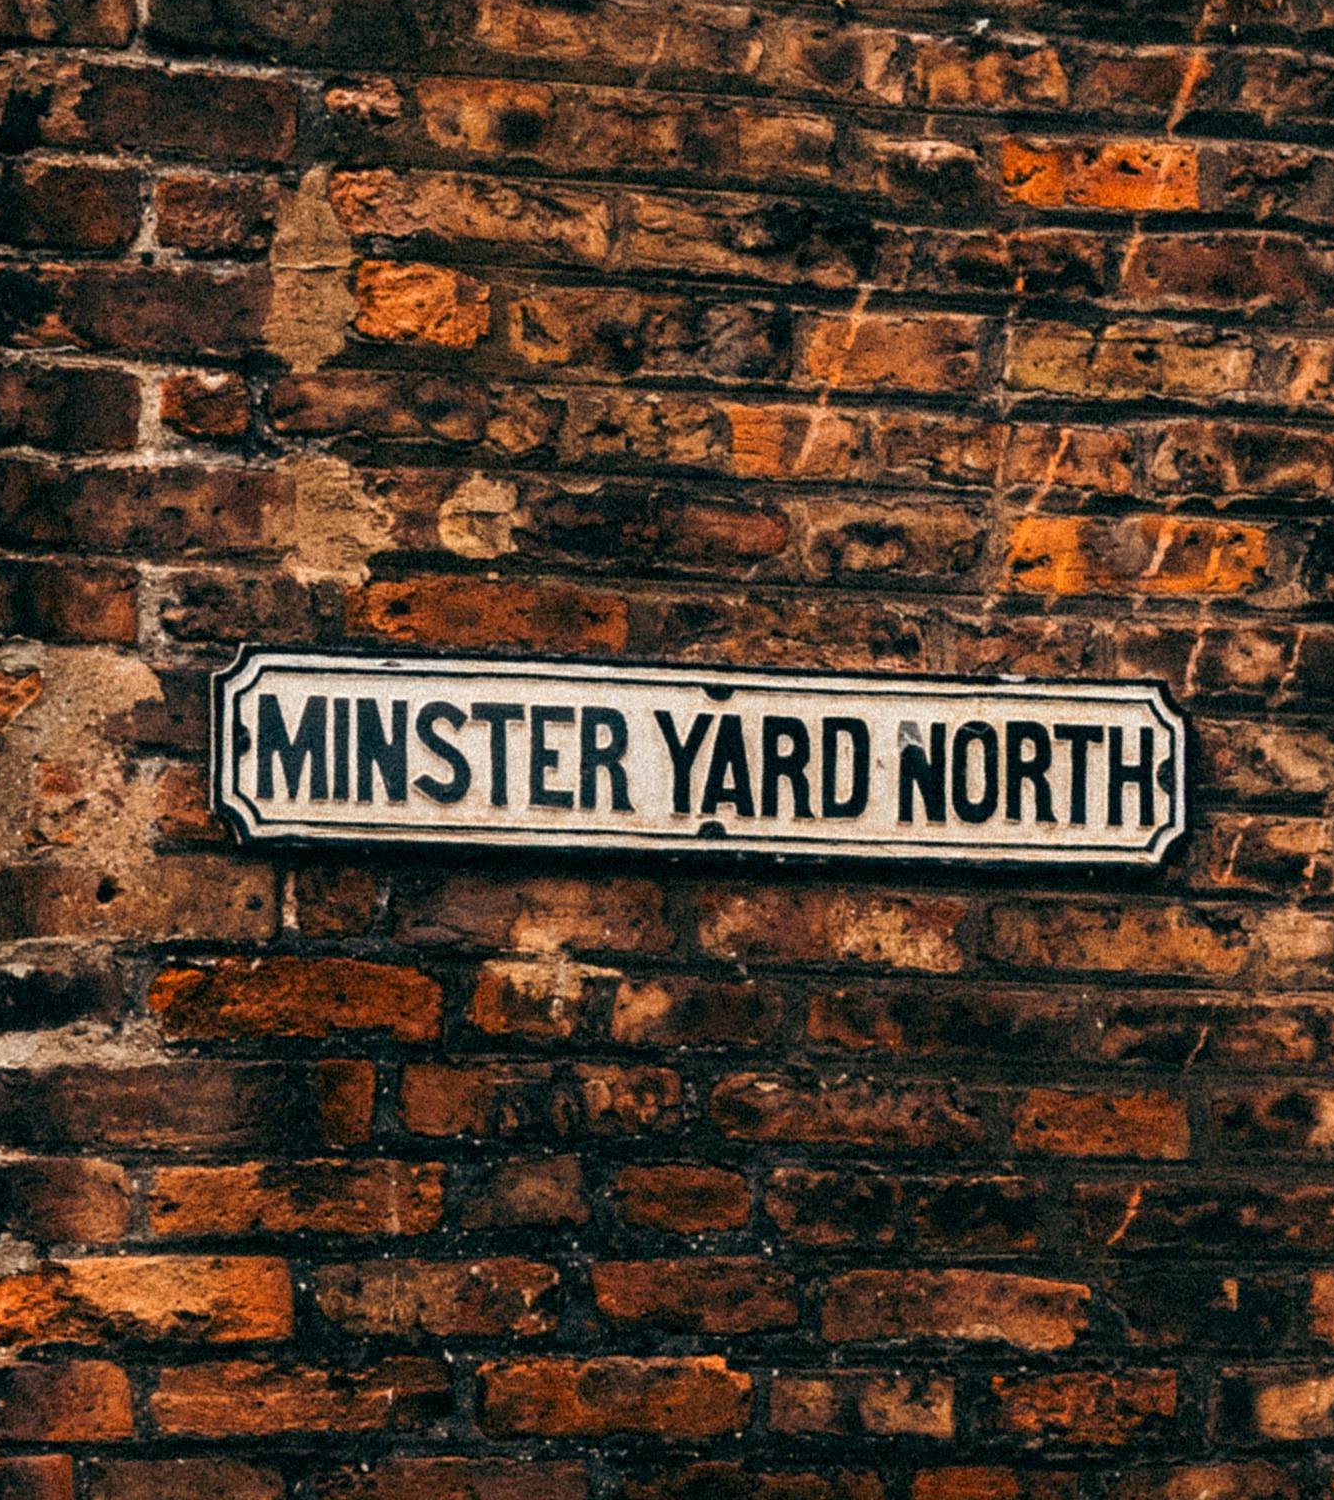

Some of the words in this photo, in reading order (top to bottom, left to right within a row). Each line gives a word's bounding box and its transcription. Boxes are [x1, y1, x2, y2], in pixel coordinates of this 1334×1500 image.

[256, 694, 634, 812] MINSTER
[654, 710, 869, 819] YARD
[898, 720, 1157, 828] NORTH
